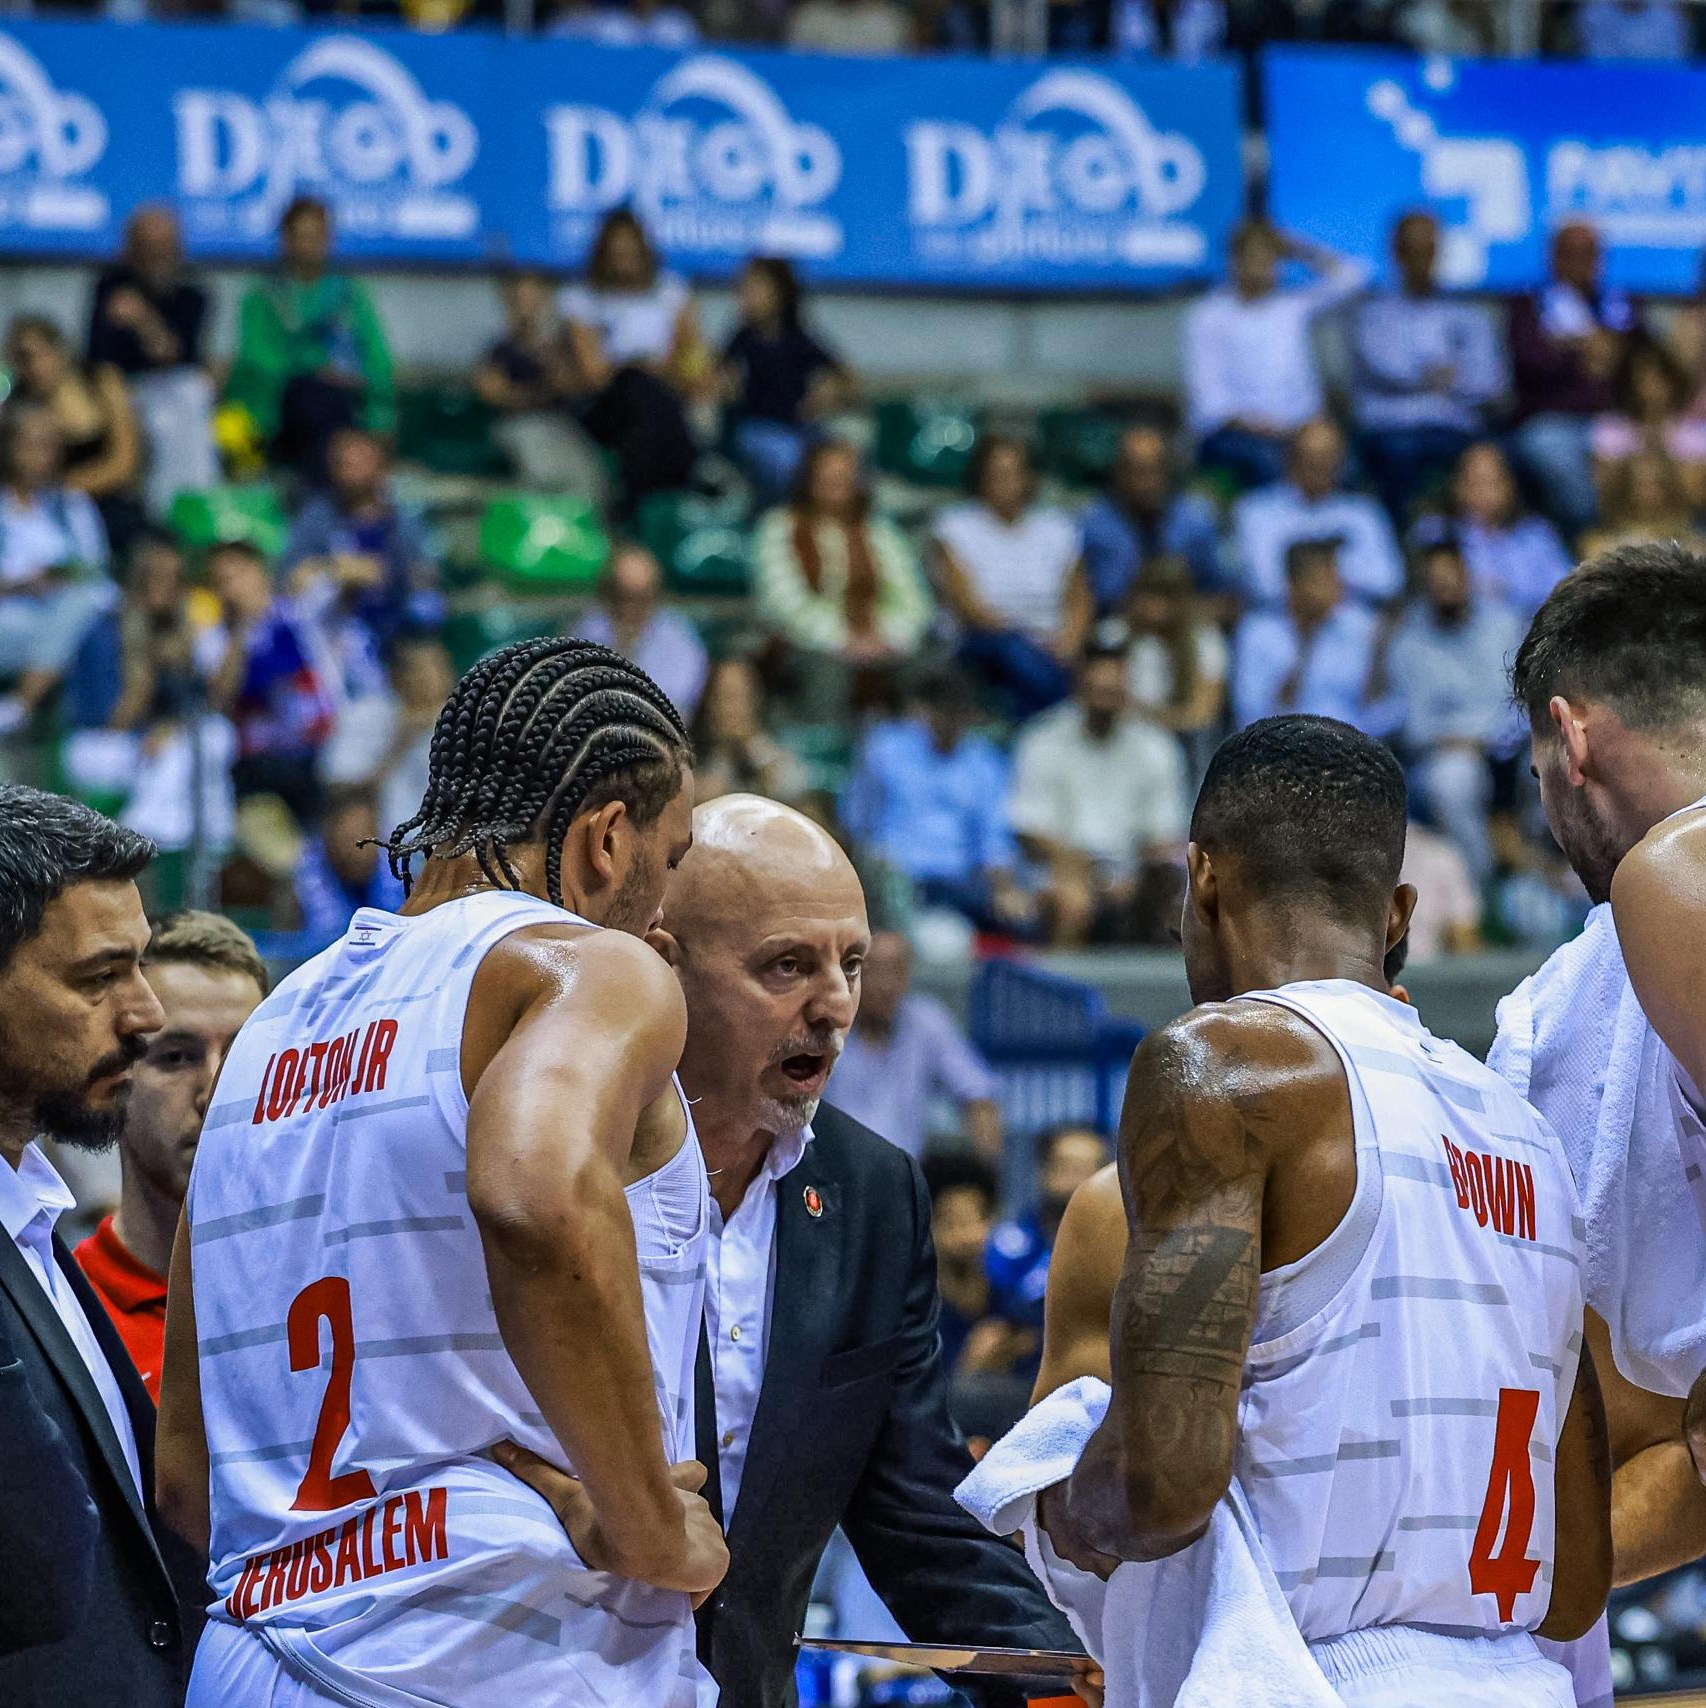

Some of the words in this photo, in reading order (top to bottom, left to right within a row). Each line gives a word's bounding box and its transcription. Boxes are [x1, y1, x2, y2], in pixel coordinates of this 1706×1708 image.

[288, 1276, 376, 1512] 2
[1468, 1388, 1541, 1623] 4
[225, 1487, 450, 1622] JERUSALEM
